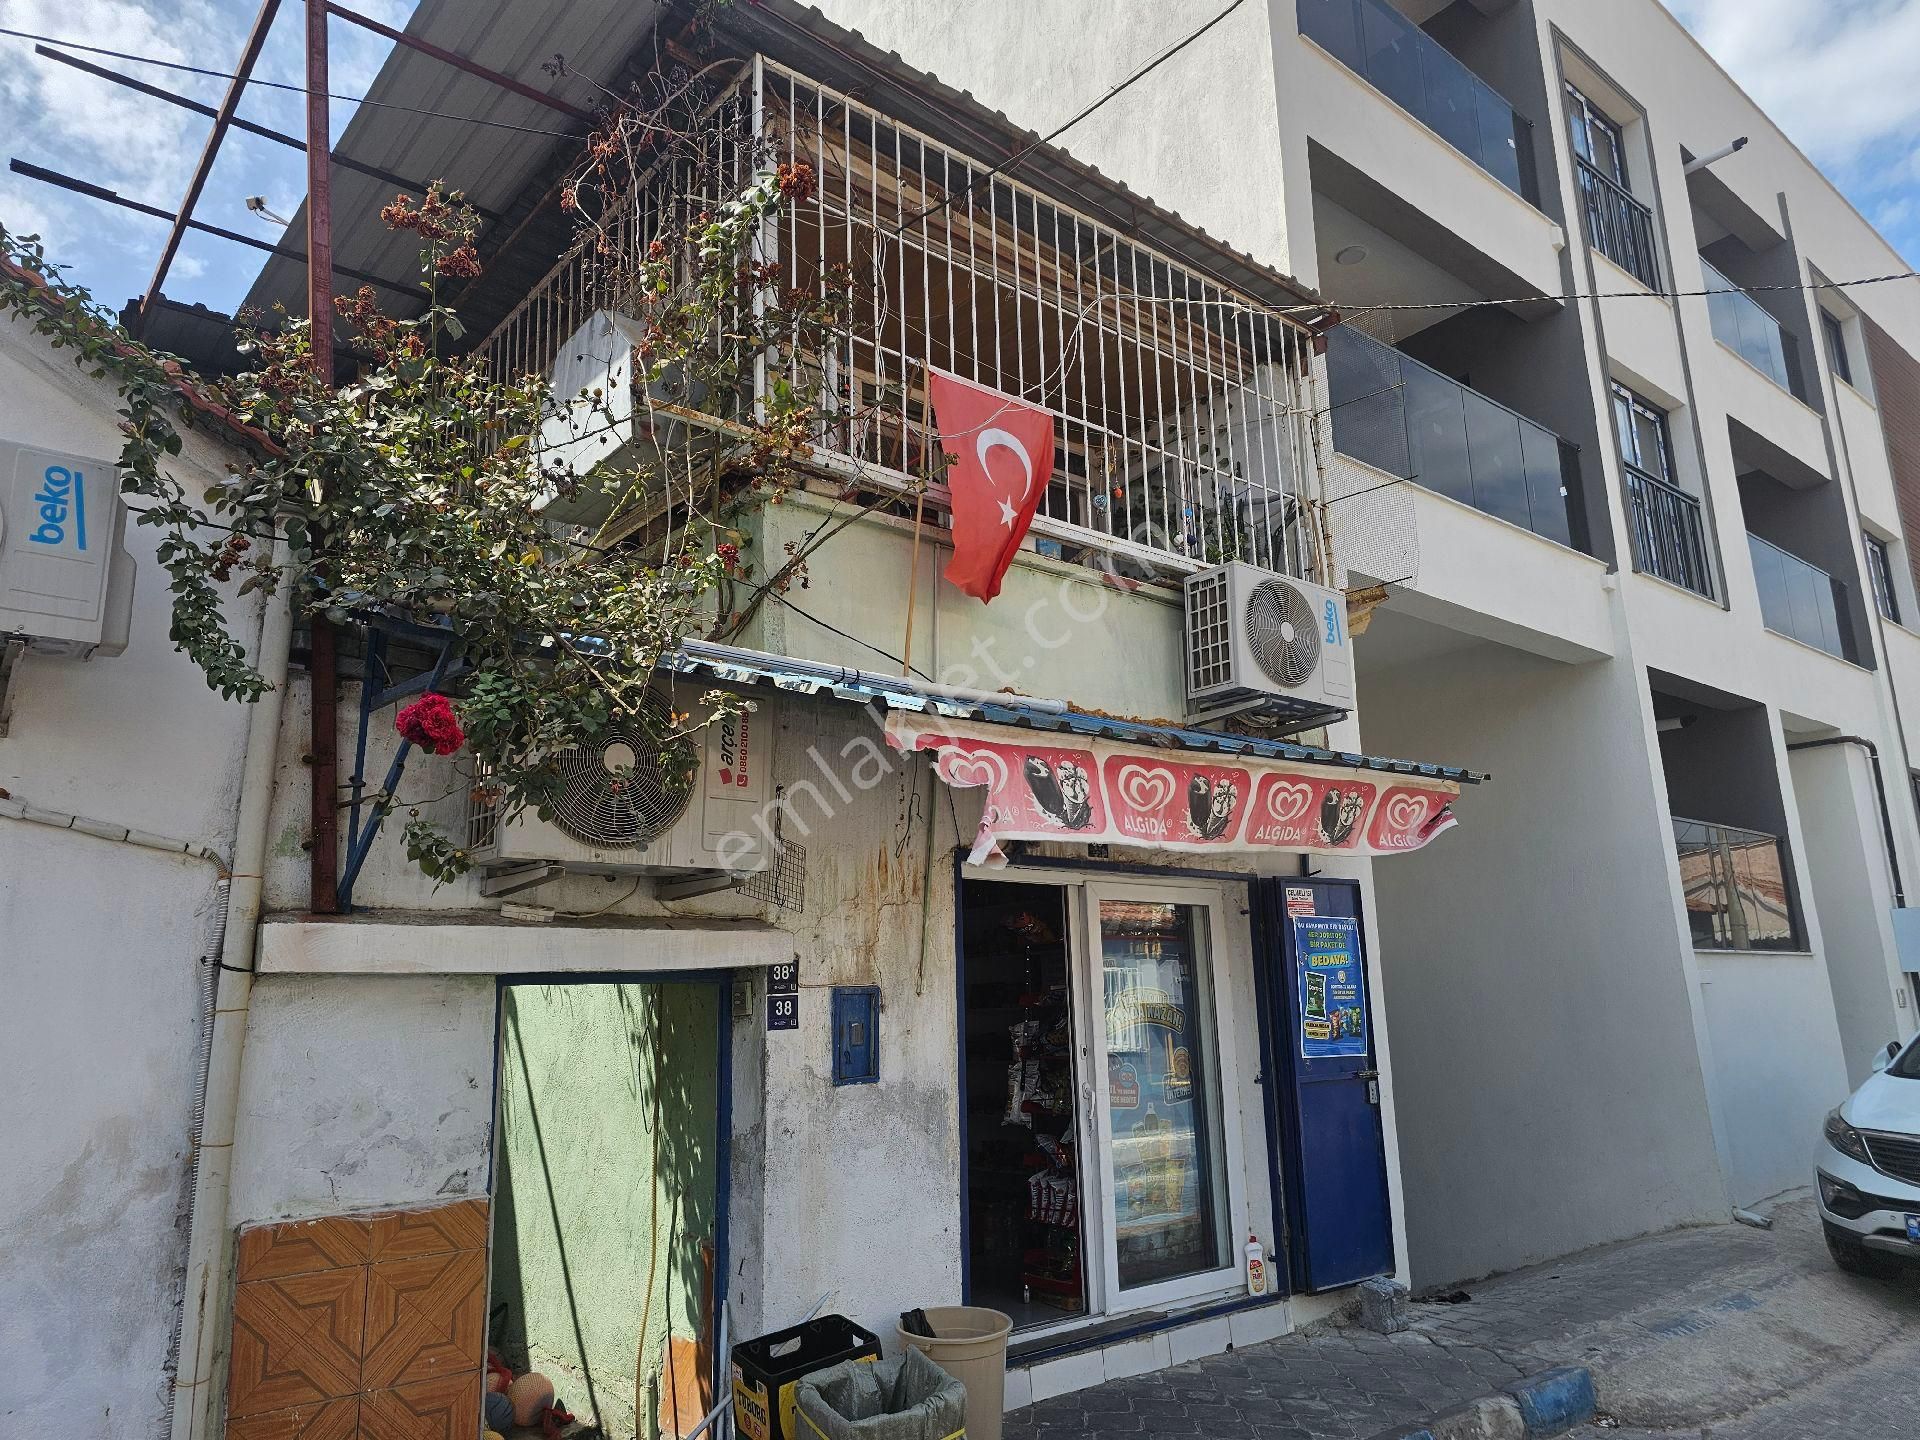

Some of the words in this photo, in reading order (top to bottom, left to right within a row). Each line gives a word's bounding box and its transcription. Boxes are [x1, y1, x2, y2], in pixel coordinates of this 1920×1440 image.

[29, 465, 72, 545] beko
[1324, 599, 1335, 645] beko
[721, 723, 738, 766] arçe
[1311, 953, 1349, 967] BEDAVA!
[775, 1000, 792, 1016] 38
[737, 1389, 766, 1426] TUBORG
